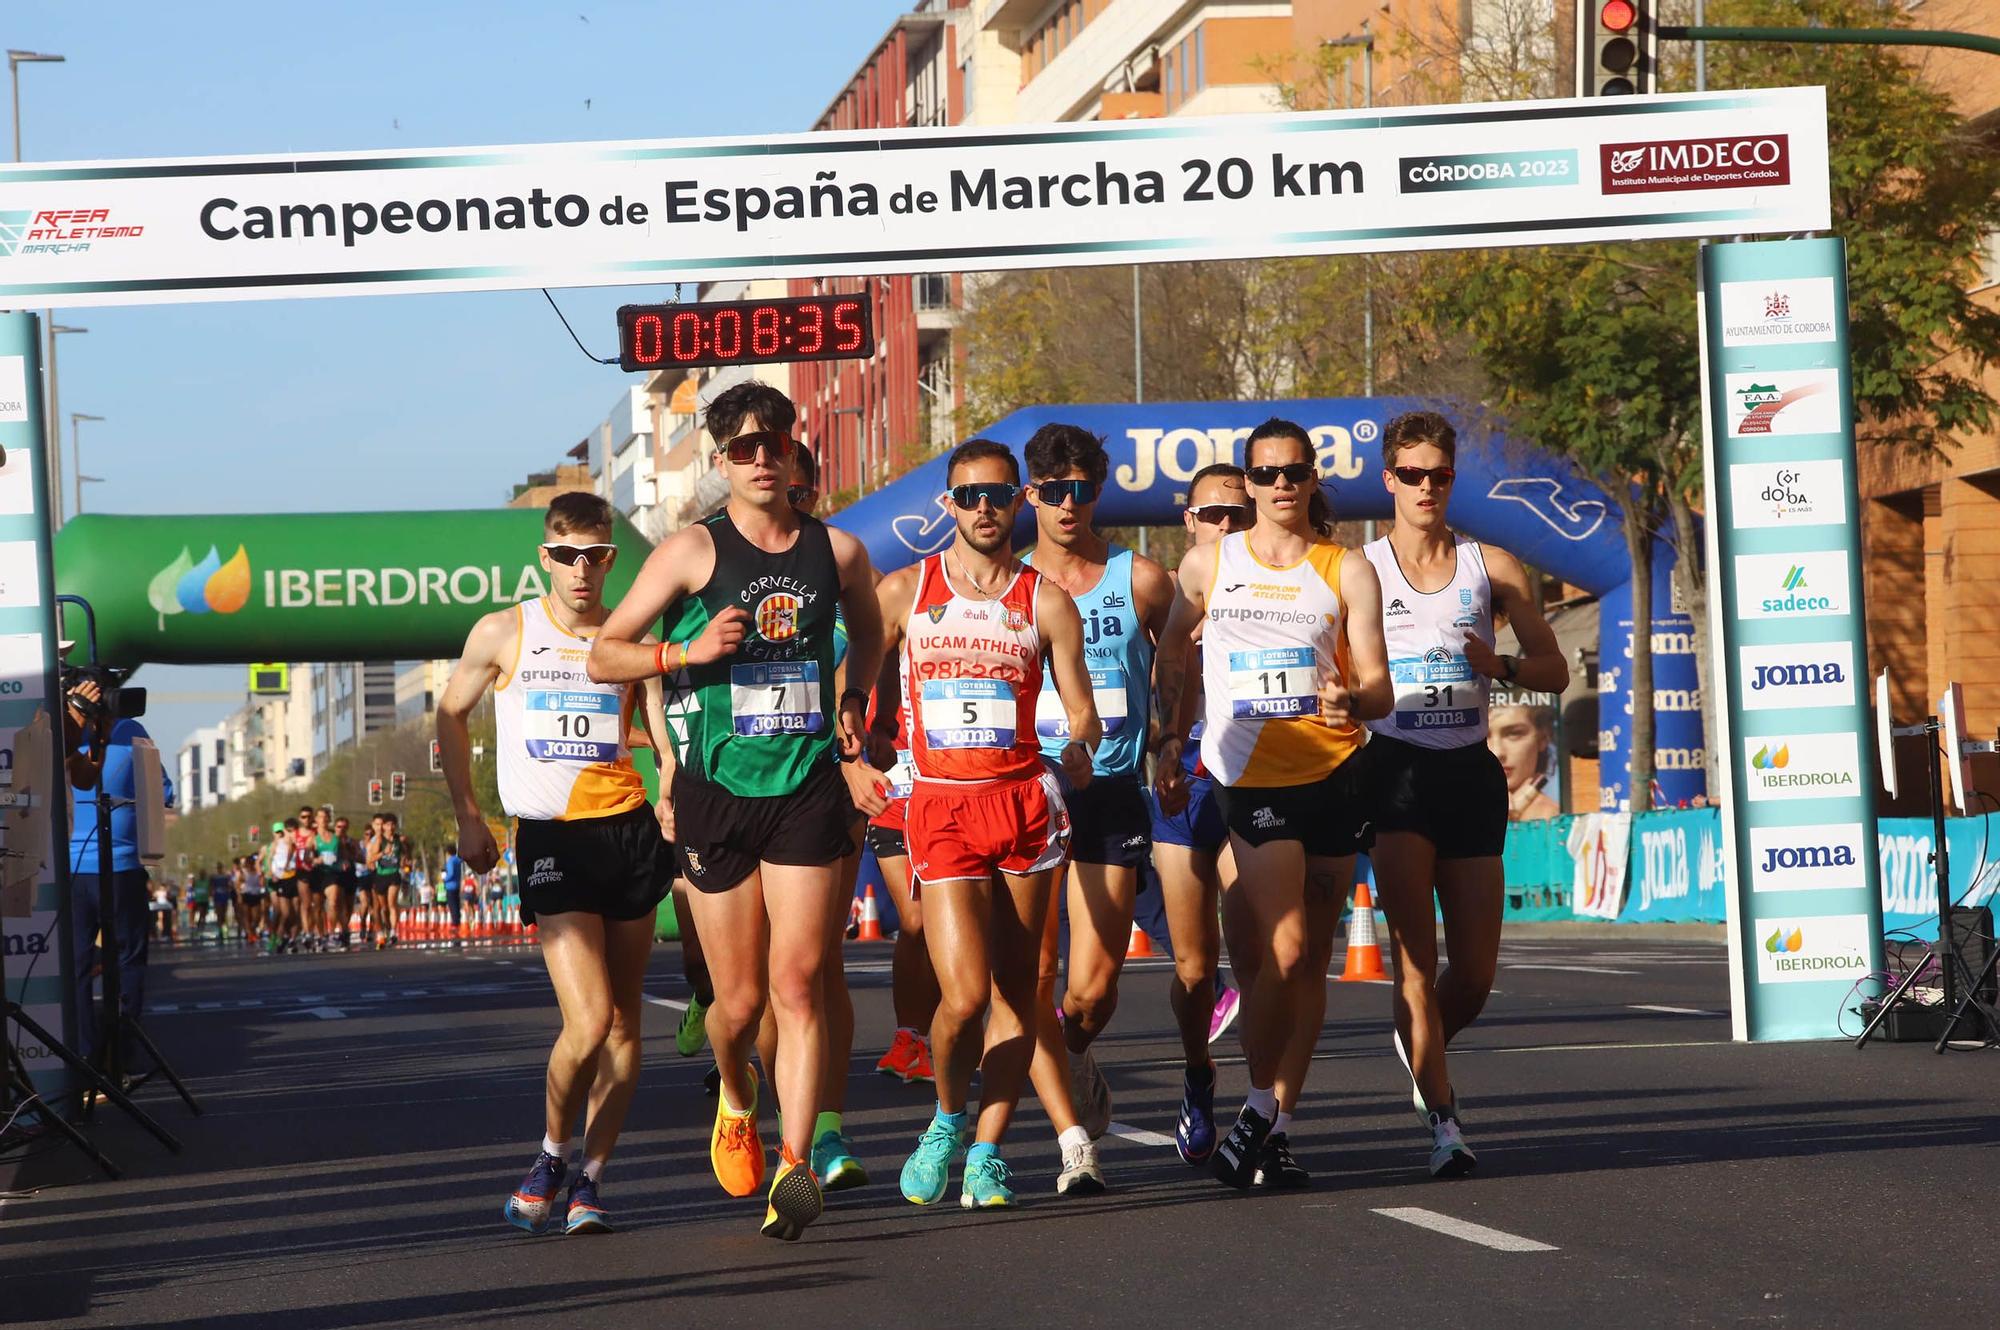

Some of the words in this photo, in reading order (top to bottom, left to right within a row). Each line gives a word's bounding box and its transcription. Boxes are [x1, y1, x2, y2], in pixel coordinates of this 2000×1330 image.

[1650, 140, 1780, 171] IMDECO
[1408, 162, 1515, 184] CÓRDOBA
[1519, 159, 1569, 177] 2023
[1612, 177, 1647, 186] Instituto
[1648, 174, 1689, 185] Municipal
[1690, 174, 1702, 182] de
[1704, 171, 1743, 183] Deportes
[1744, 169, 1780, 179] Córdoba
[200, 188, 590, 247] Campeonato
[600, 195, 648, 226] de
[665, 170, 879, 232] España
[889, 184, 938, 214] de
[950, 160, 1165, 212] Marcha
[1181, 156, 1254, 202] 20
[1272, 152, 1365, 197] km
[34, 208, 110, 228] RFEA
[28, 225, 145, 240] ATLETISMO
[21, 243, 91, 255] MARCHA
[634, 302, 862, 364] 00:08:35
[1726, 325, 1782, 337] AYUNTAMIENTO
[1784, 324, 1793, 334] DE
[264, 564, 548, 608] IBERDROLA
[1762, 593, 1830, 612] sadeco
[1211, 608, 1317, 625] grupompleo
[920, 636, 966, 650] UCAM
[1258, 671, 1287, 694] 11
[1751, 663, 1845, 691] Joma
[771, 686, 786, 710] 7
[1424, 685, 1453, 708] 31
[963, 701, 978, 724] 5
[1249, 698, 1302, 716] Joma
[557, 714, 590, 738] 10
[754, 714, 807, 732] Joma
[1414, 710, 1467, 728] Joma
[943, 730, 998, 745] Joma
[544, 741, 600, 758] Joma
[1763, 771, 1853, 787] IBERDROLA
[1761, 845, 1856, 873] Joma
[1776, 955, 1866, 971] IBERDROLA
